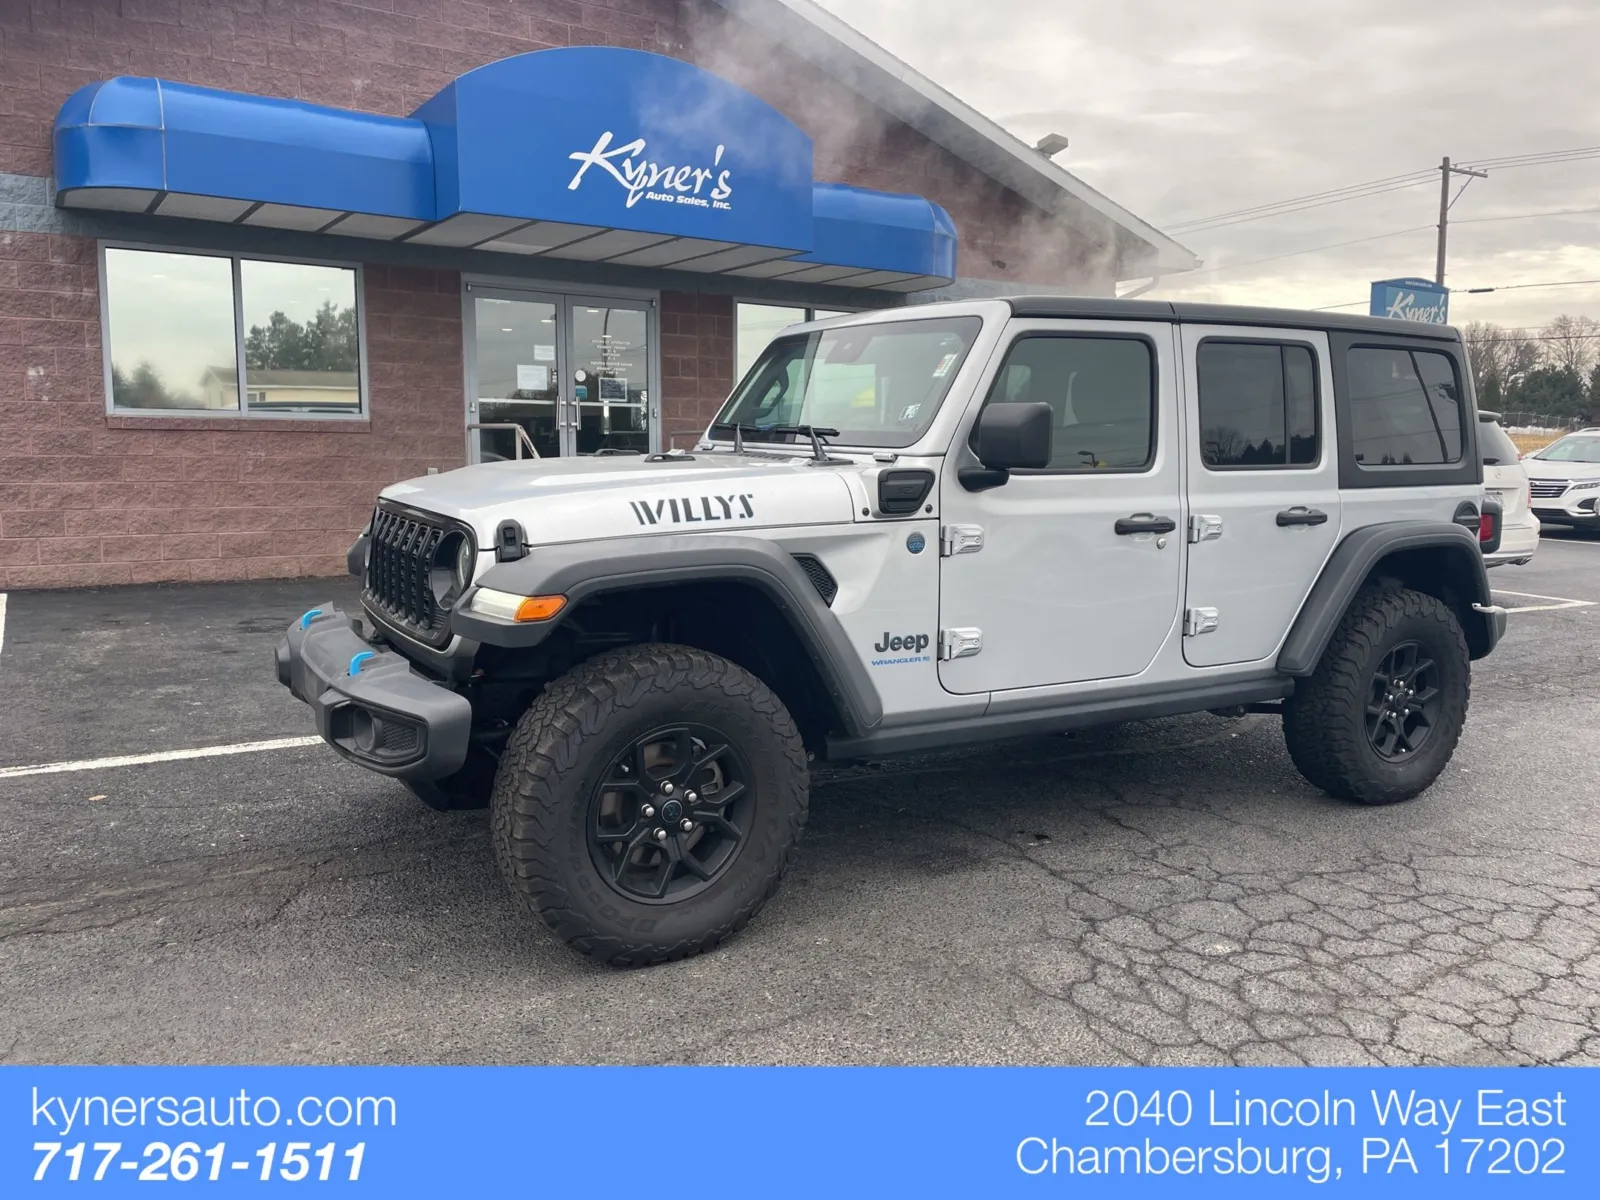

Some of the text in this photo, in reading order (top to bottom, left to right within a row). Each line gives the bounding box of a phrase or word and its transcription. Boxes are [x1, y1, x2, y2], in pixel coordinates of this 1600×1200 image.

[568, 131, 732, 208] Kyner's
[645, 191, 732, 210] Auto Sales, Inc.
[629, 494, 754, 525] WILLYS
[874, 631, 929, 653] Jeep
[871, 656, 921, 667] WRANGLER
